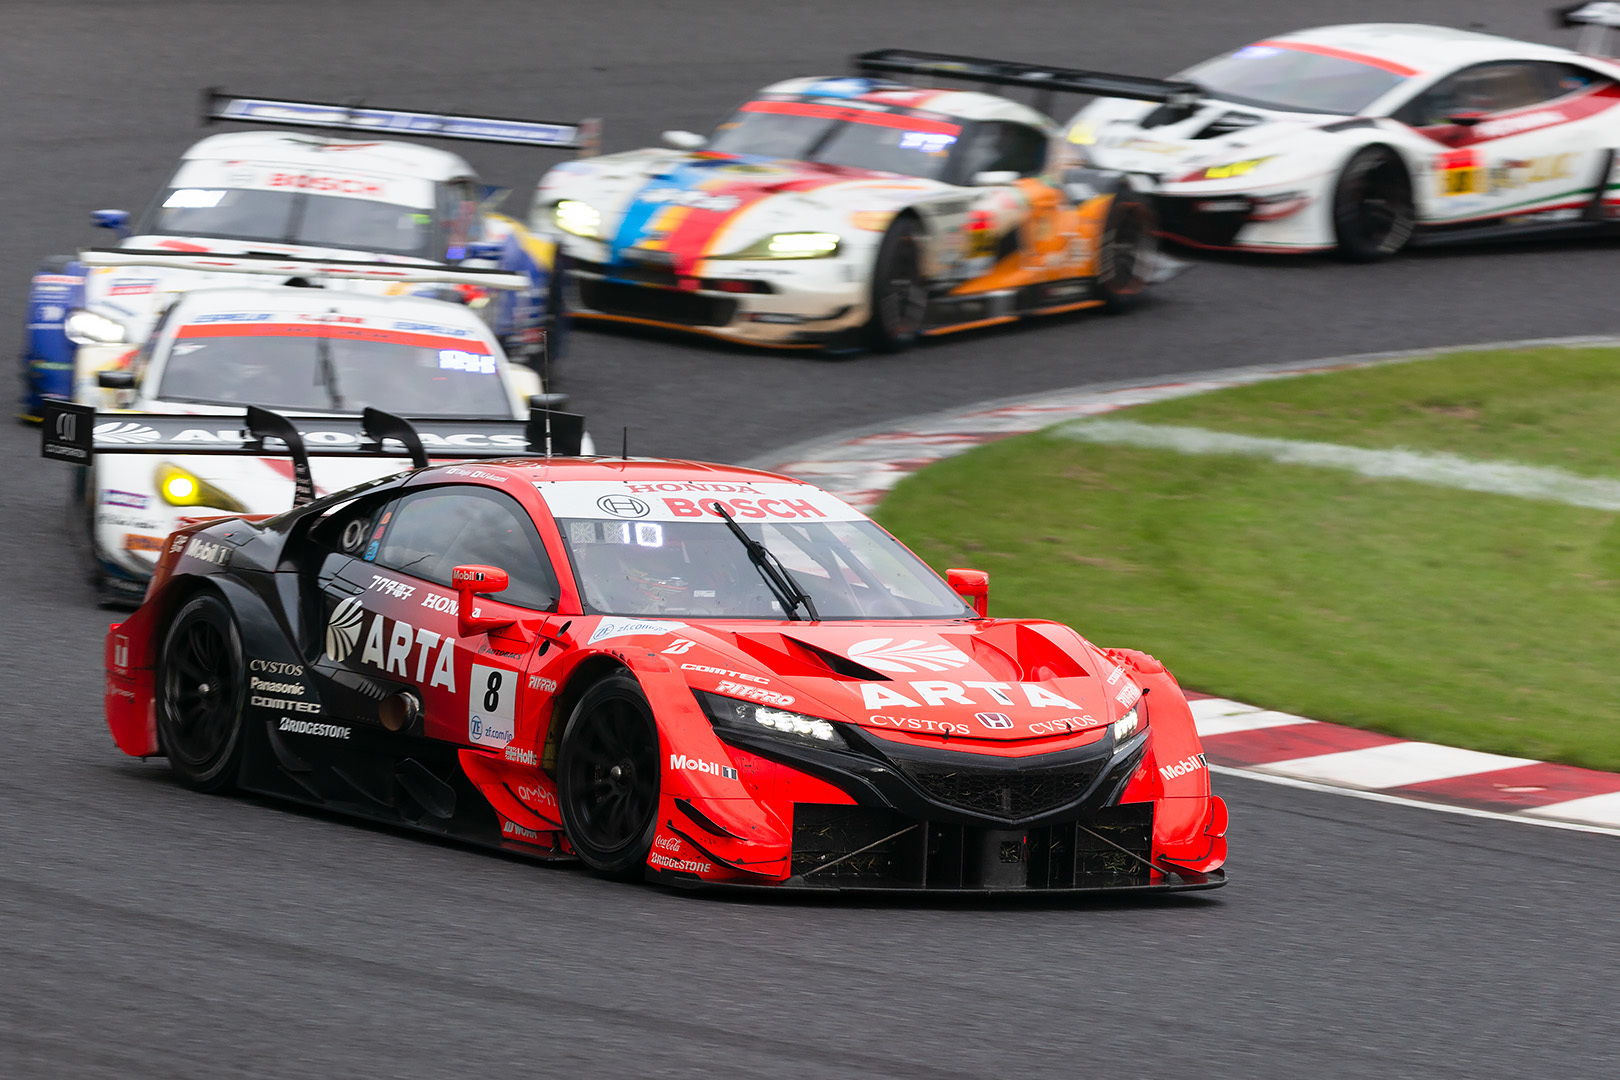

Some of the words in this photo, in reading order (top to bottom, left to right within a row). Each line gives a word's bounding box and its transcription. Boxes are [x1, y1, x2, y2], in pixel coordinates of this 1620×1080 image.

[170, 429, 532, 446] AUOACS
[625, 483, 765, 495] HONDA
[661, 497, 827, 519] BOSCH
[622, 521, 663, 547] 10
[185, 538, 219, 563] Mobil
[453, 570, 474, 580] Mobil
[476, 572, 485, 581] 1
[421, 593, 482, 618] HONA
[361, 614, 456, 694] ARTA
[250, 659, 304, 676] CVSTOS
[681, 663, 770, 685] COMTEC
[250, 676, 305, 696] Panasonic
[483, 671, 503, 713] 8
[860, 680, 1083, 711] ARTA
[251, 695, 321, 714] COMTEC
[278, 716, 352, 740] BRIDGESTONE
[869, 715, 971, 735] CVSTOS
[1028, 714, 1099, 736] CVSTOS
[516, 747, 537, 766] Holts
[669, 754, 719, 776] Mobil
[722, 765, 738, 781] 1
[1159, 755, 1200, 781] Mobil
[1197, 753, 1209, 767] 1
[650, 851, 712, 873] BRIDGESTONE
